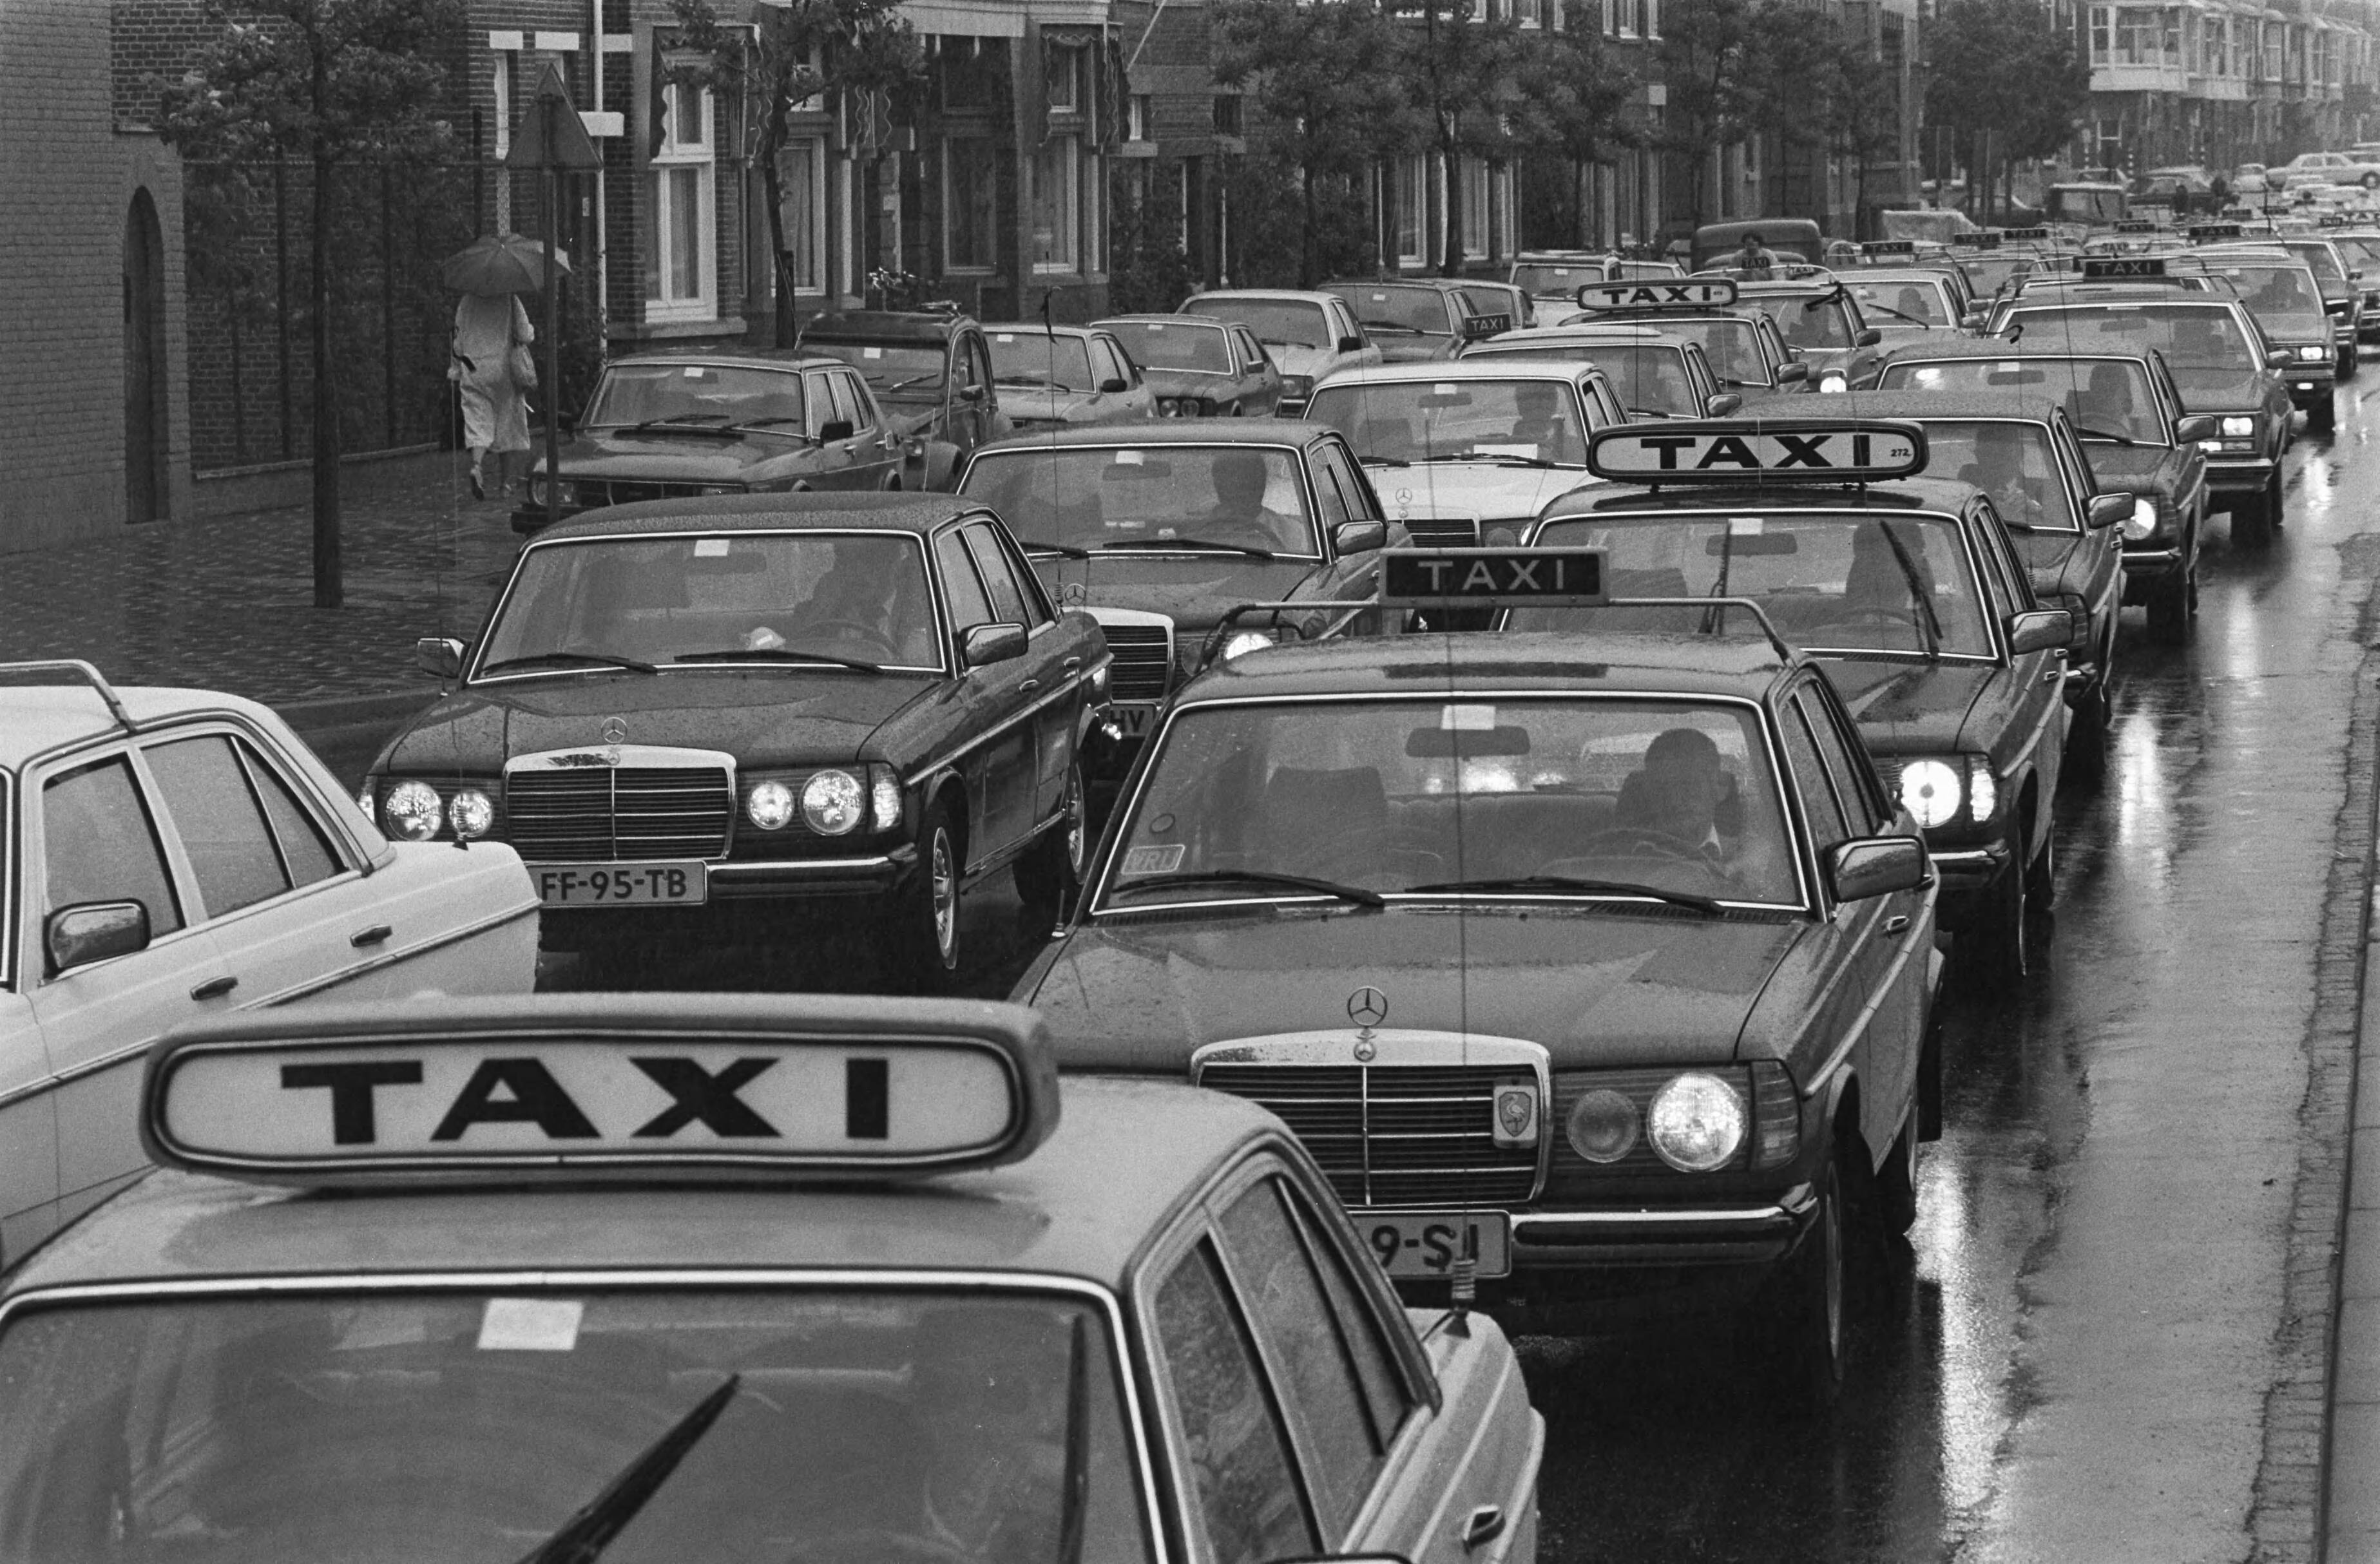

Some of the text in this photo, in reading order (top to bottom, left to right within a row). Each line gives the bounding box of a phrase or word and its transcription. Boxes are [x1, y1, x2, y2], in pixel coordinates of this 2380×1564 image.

[1742, 258, 1770, 268] TAXI
[2097, 262, 2151, 274] TAXI
[1602, 286, 1711, 305] TAXI
[1471, 318, 1504, 332] TAXI
[1640, 434, 1910, 470] TAXI 272
[1418, 558, 1564, 591] TAXI
[541, 868, 687, 901] FF-95-TB
[280, 1057, 890, 1145] TAXI
